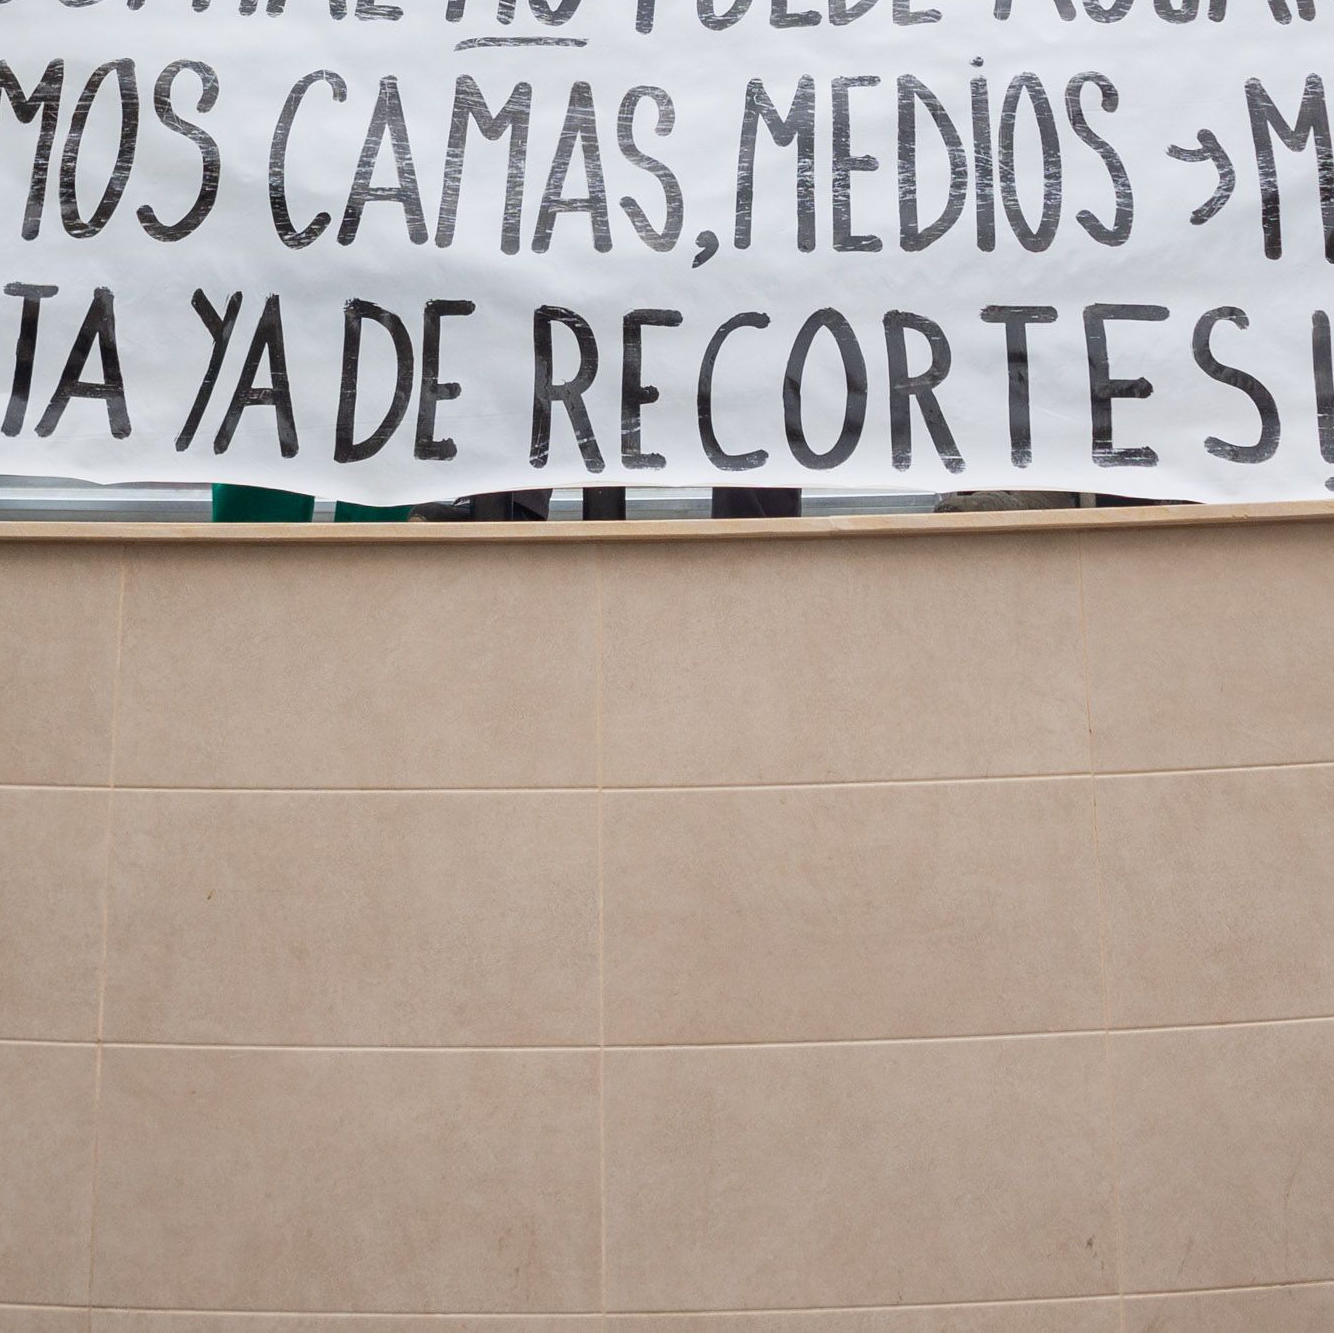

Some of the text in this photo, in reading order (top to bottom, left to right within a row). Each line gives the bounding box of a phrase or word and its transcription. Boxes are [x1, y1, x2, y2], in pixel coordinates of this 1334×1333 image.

[267, 69, 720, 269] CAMAS,
[175, 287, 299, 458] YA
[334, 298, 476, 464] DE
